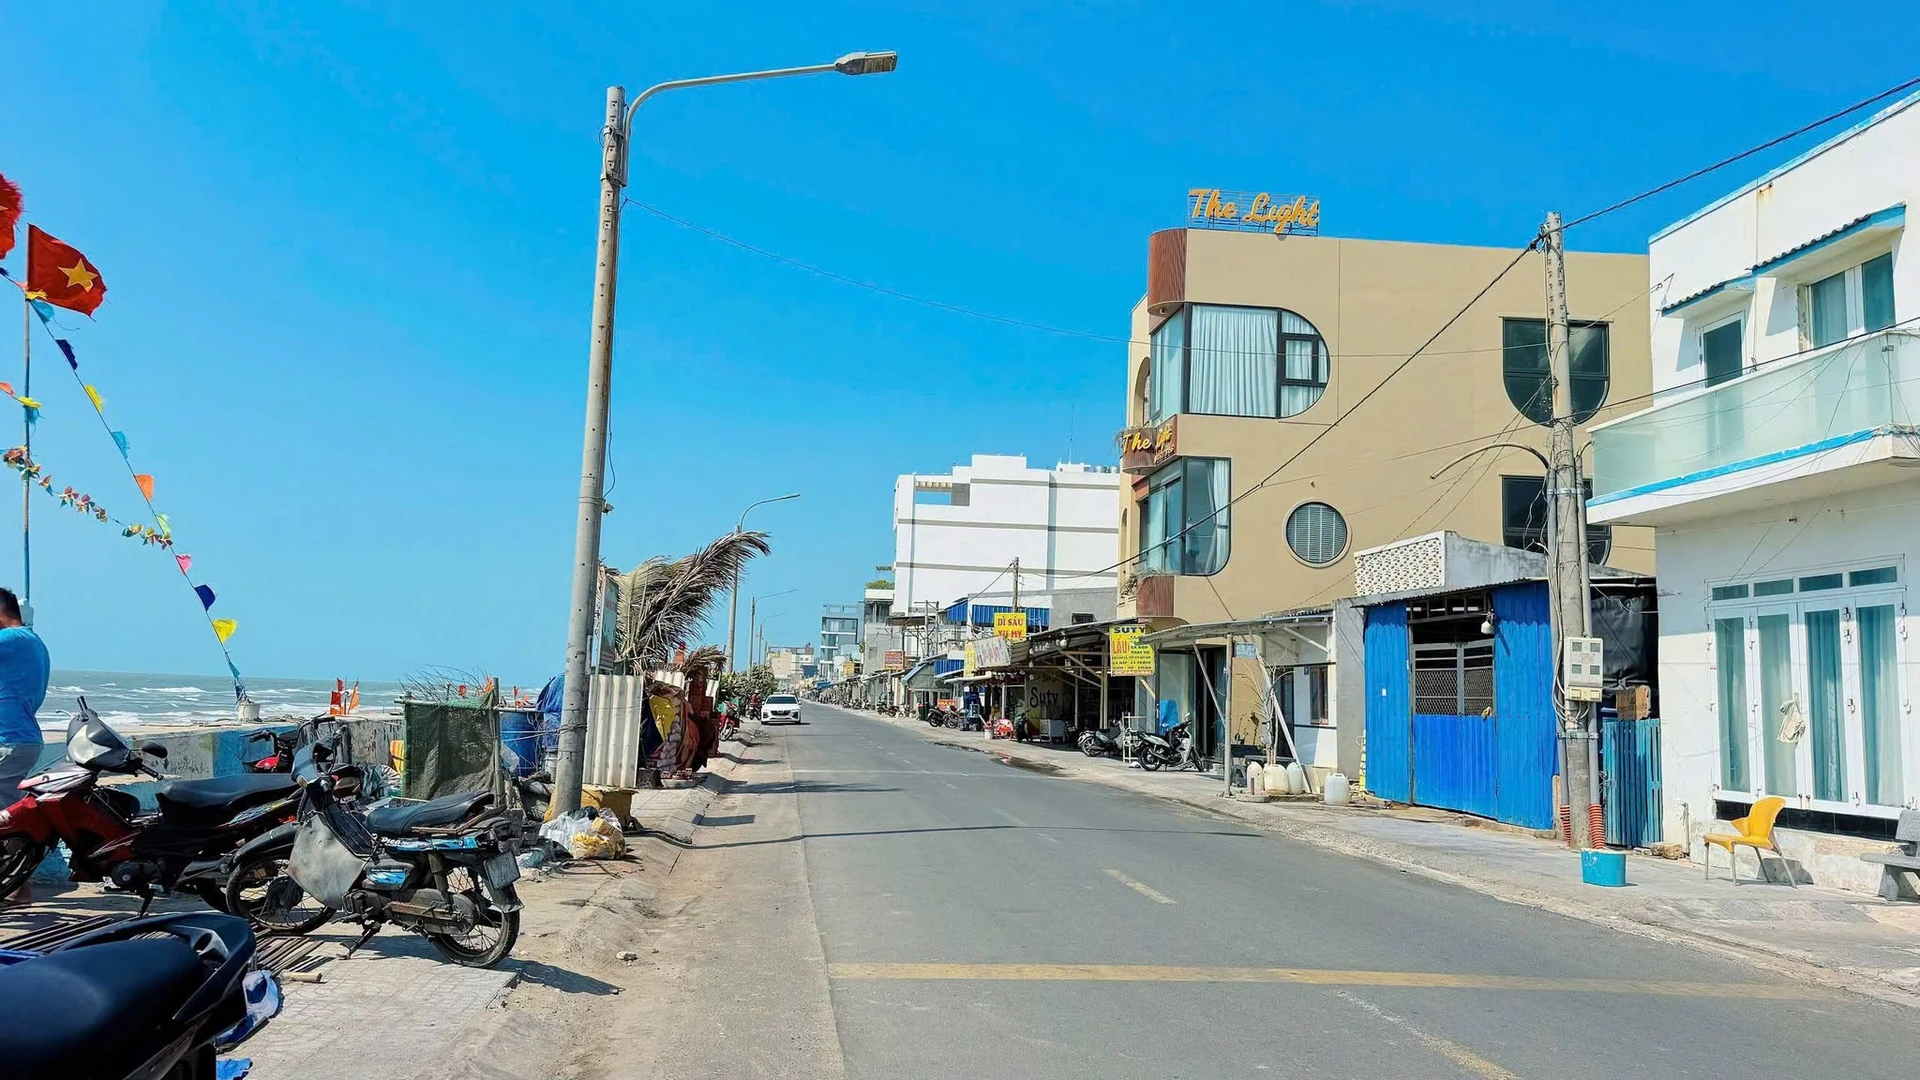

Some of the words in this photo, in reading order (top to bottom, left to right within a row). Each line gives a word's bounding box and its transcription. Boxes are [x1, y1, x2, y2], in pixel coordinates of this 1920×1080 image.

[1189, 188, 1237, 218] The
[1242, 192, 1320, 234] Light
[1122, 431, 1153, 455] The
[1113, 626, 1146, 634] SUTY
[1030, 686, 1059, 708] Suty
